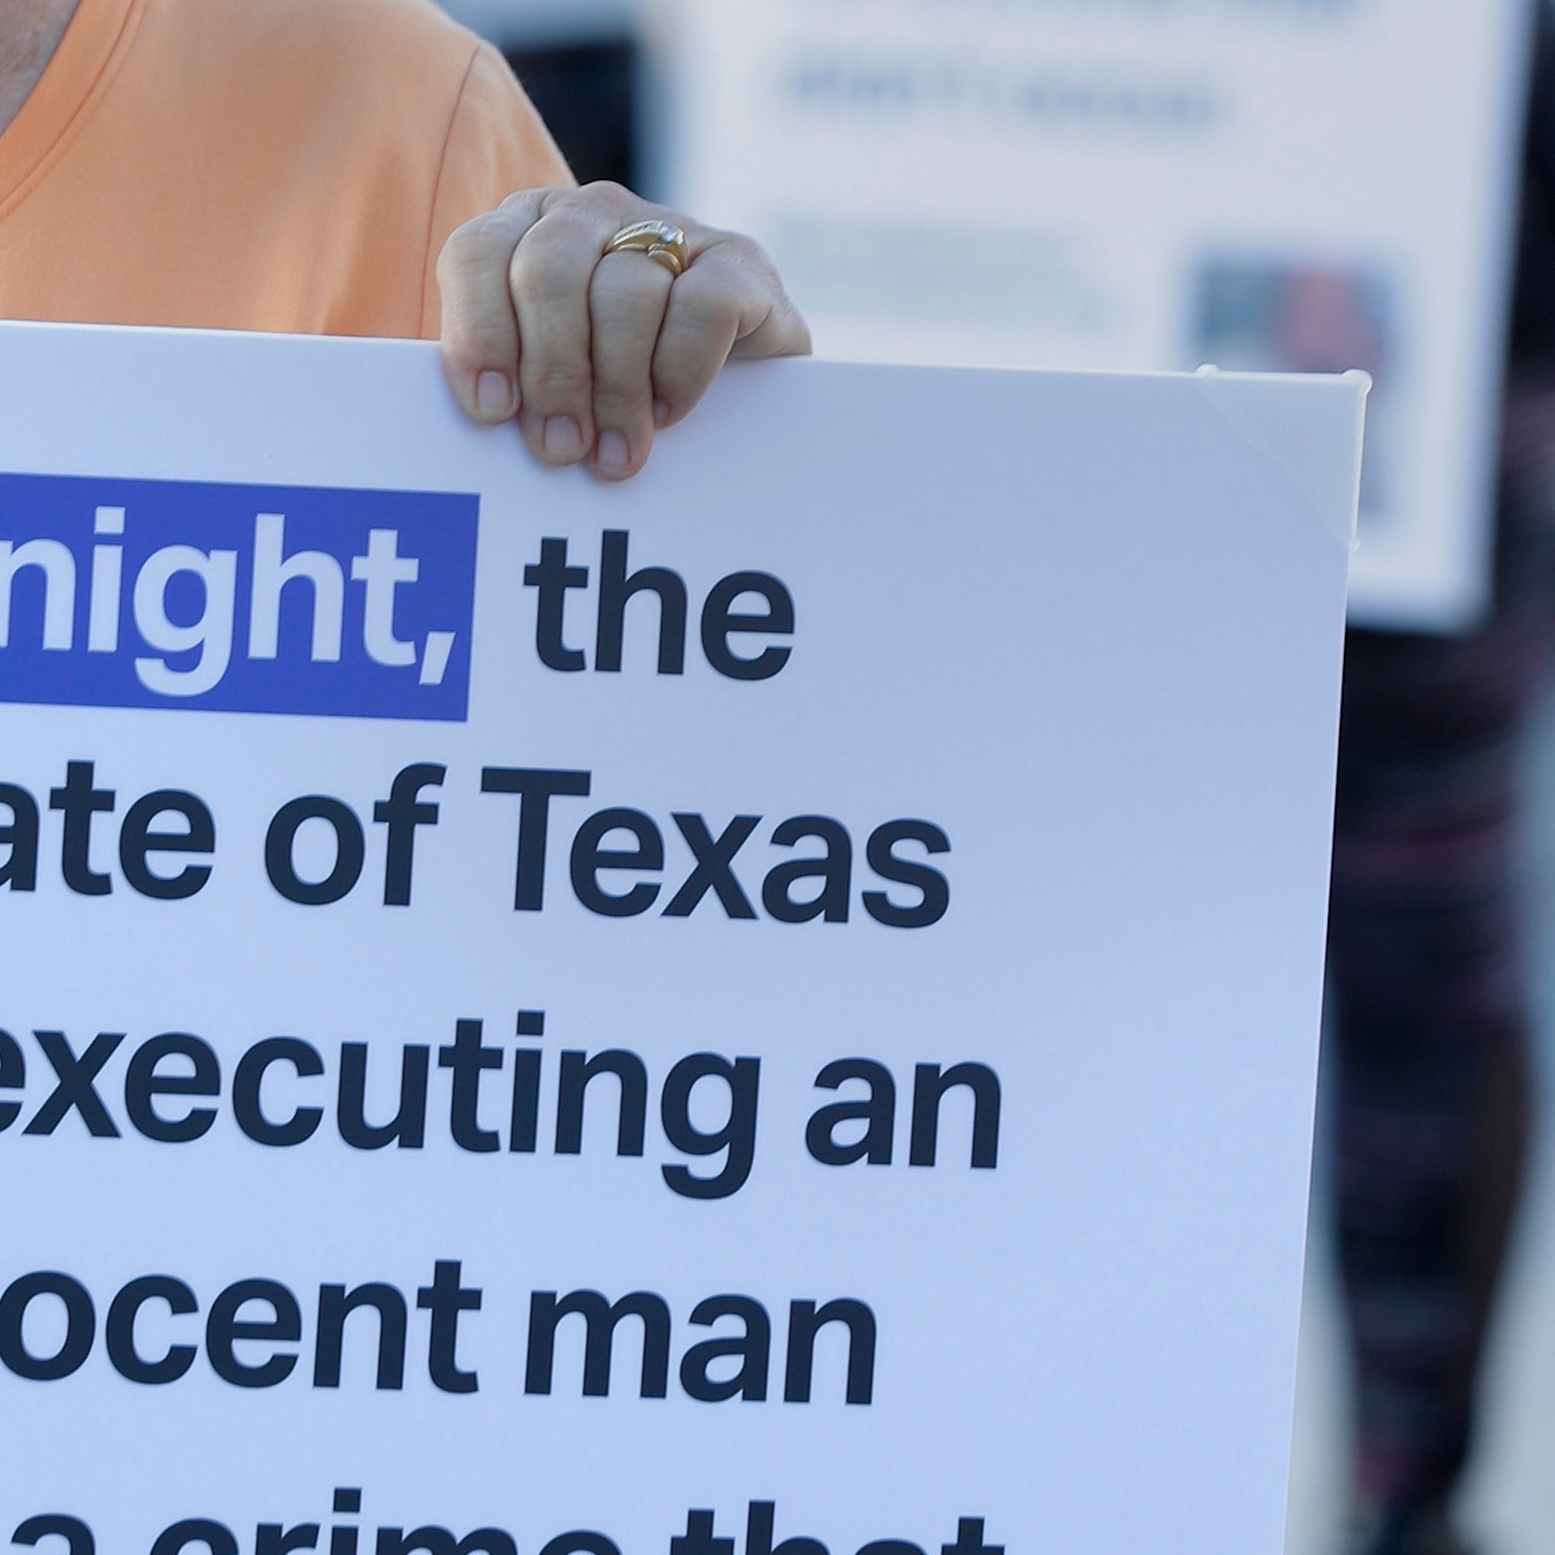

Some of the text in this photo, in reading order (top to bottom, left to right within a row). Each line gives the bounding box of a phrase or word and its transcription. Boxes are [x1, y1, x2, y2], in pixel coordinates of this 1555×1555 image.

[523, 528, 797, 682] the
[264, 761, 447, 908] of
[480, 765, 953, 931] Texas
[804, 1056, 1003, 1171] an
[523, 1288, 878, 1407] man
